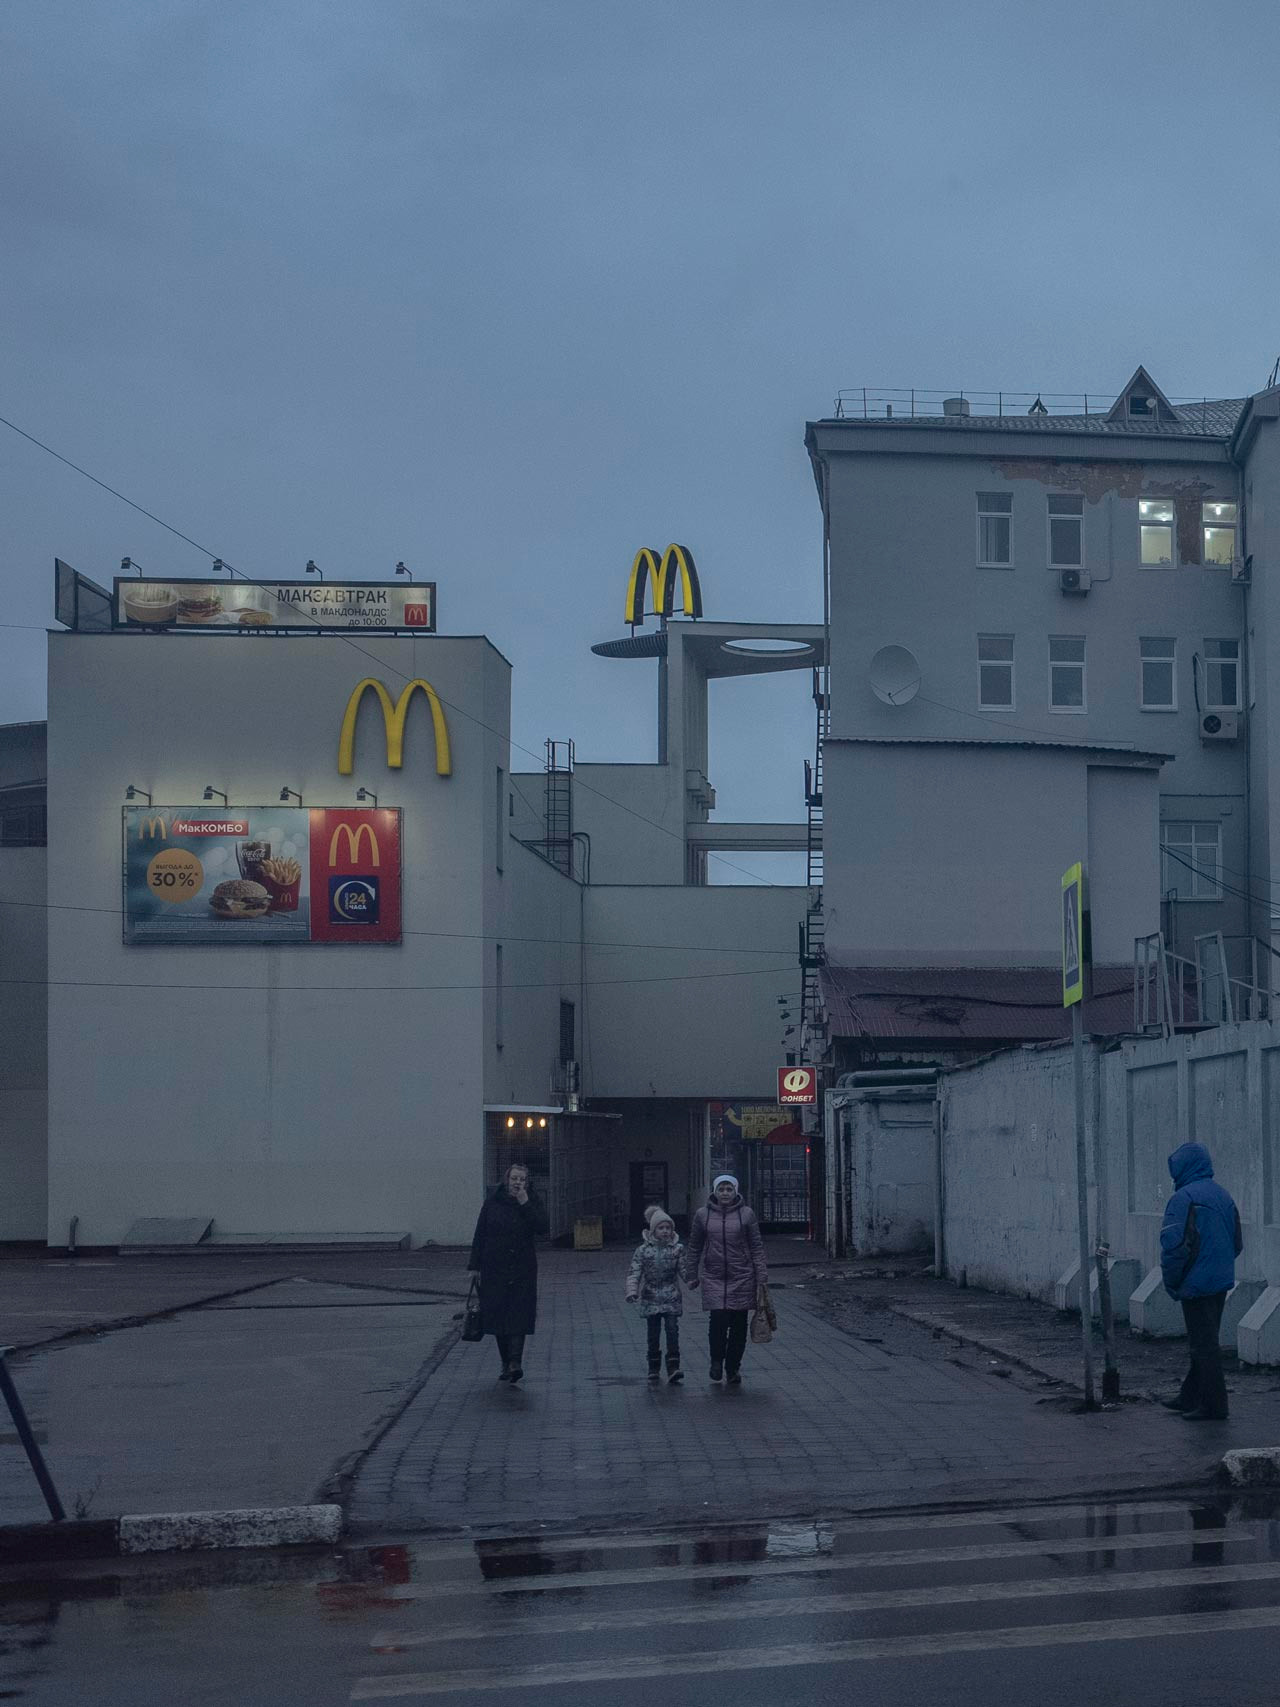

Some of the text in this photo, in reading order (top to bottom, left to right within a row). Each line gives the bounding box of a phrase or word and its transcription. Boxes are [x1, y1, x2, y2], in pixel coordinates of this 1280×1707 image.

[277, 589, 387, 604] МАКЗАВТРАК
[311, 608, 318, 616] В
[362, 618, 387, 626] 10:00
[178, 823, 243, 833] МакКОМБО
[349, 892, 367, 905] 24
[783, 1069, 811, 1093] Ф
